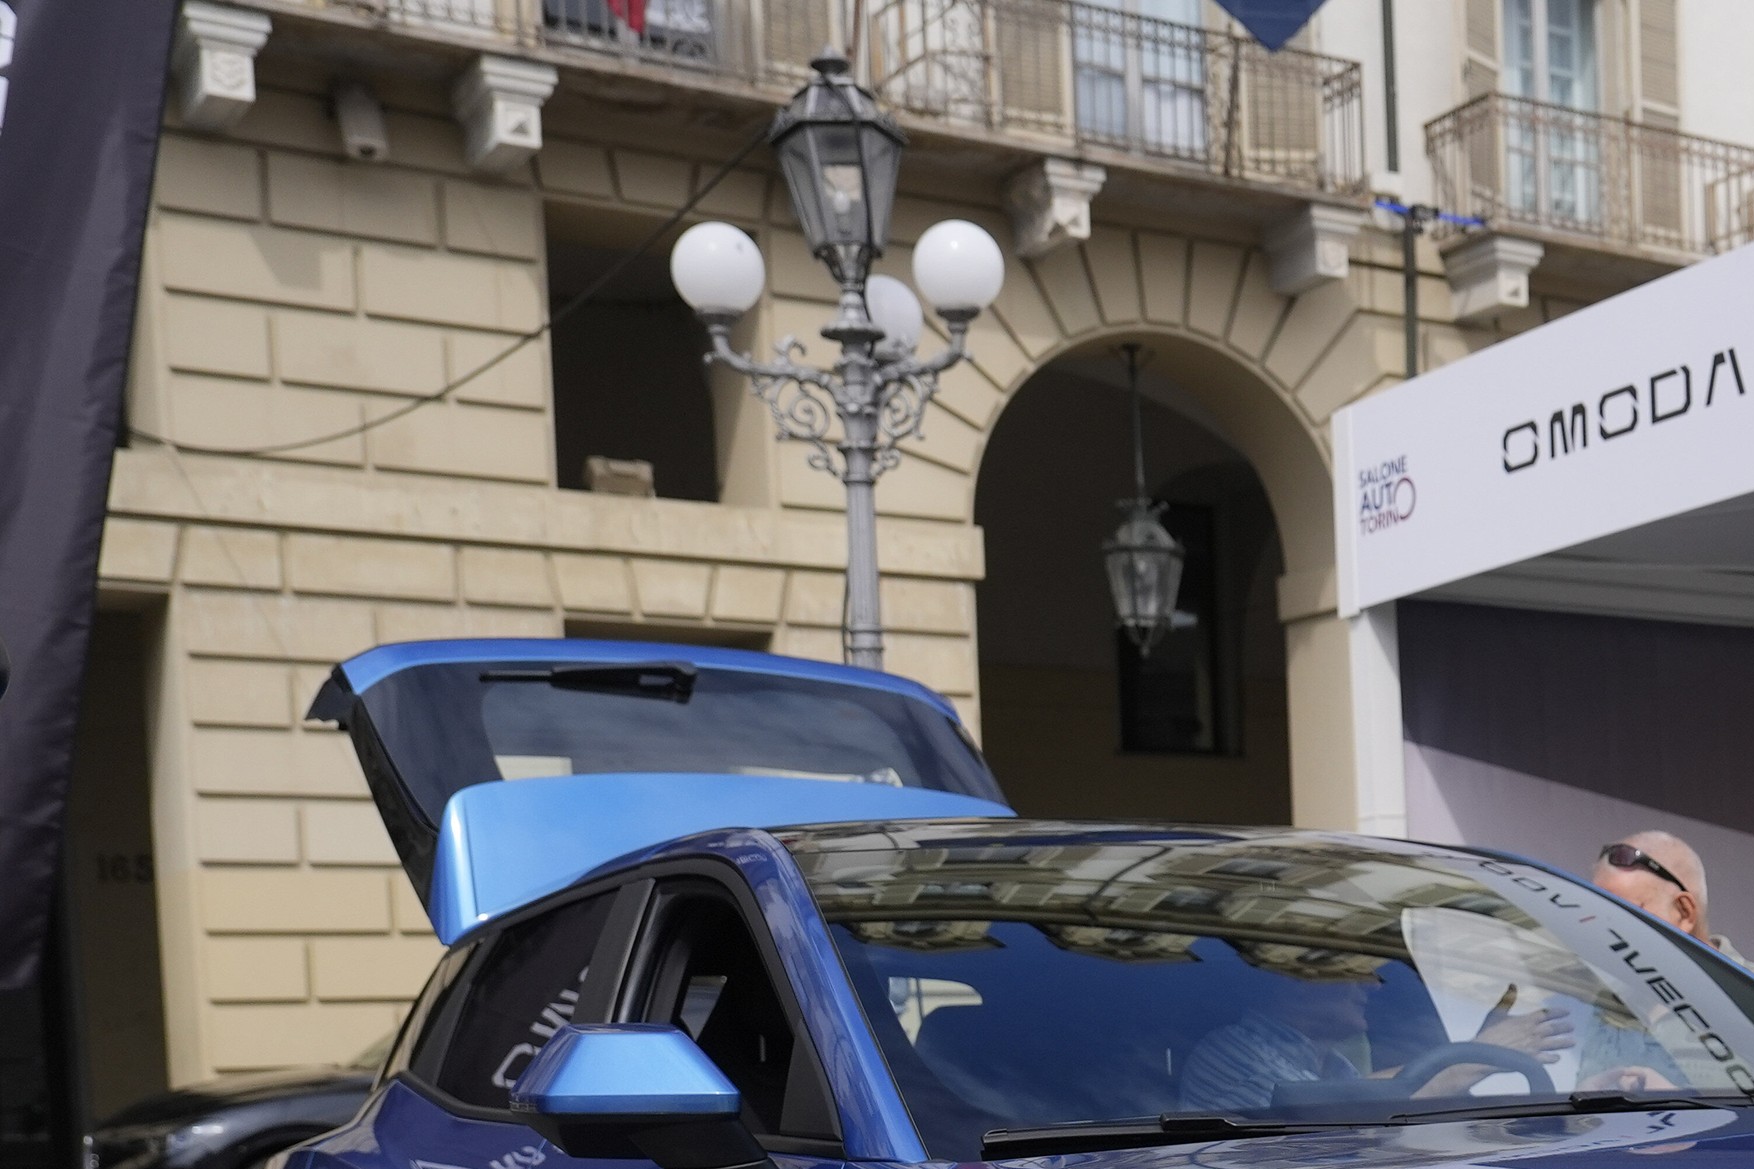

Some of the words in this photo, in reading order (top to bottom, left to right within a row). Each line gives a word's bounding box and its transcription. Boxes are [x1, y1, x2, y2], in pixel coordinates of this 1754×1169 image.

[1502, 349, 1745, 474] OMODA
[1359, 455, 1407, 489] SALONE
[1360, 477, 1416, 521] AUTO
